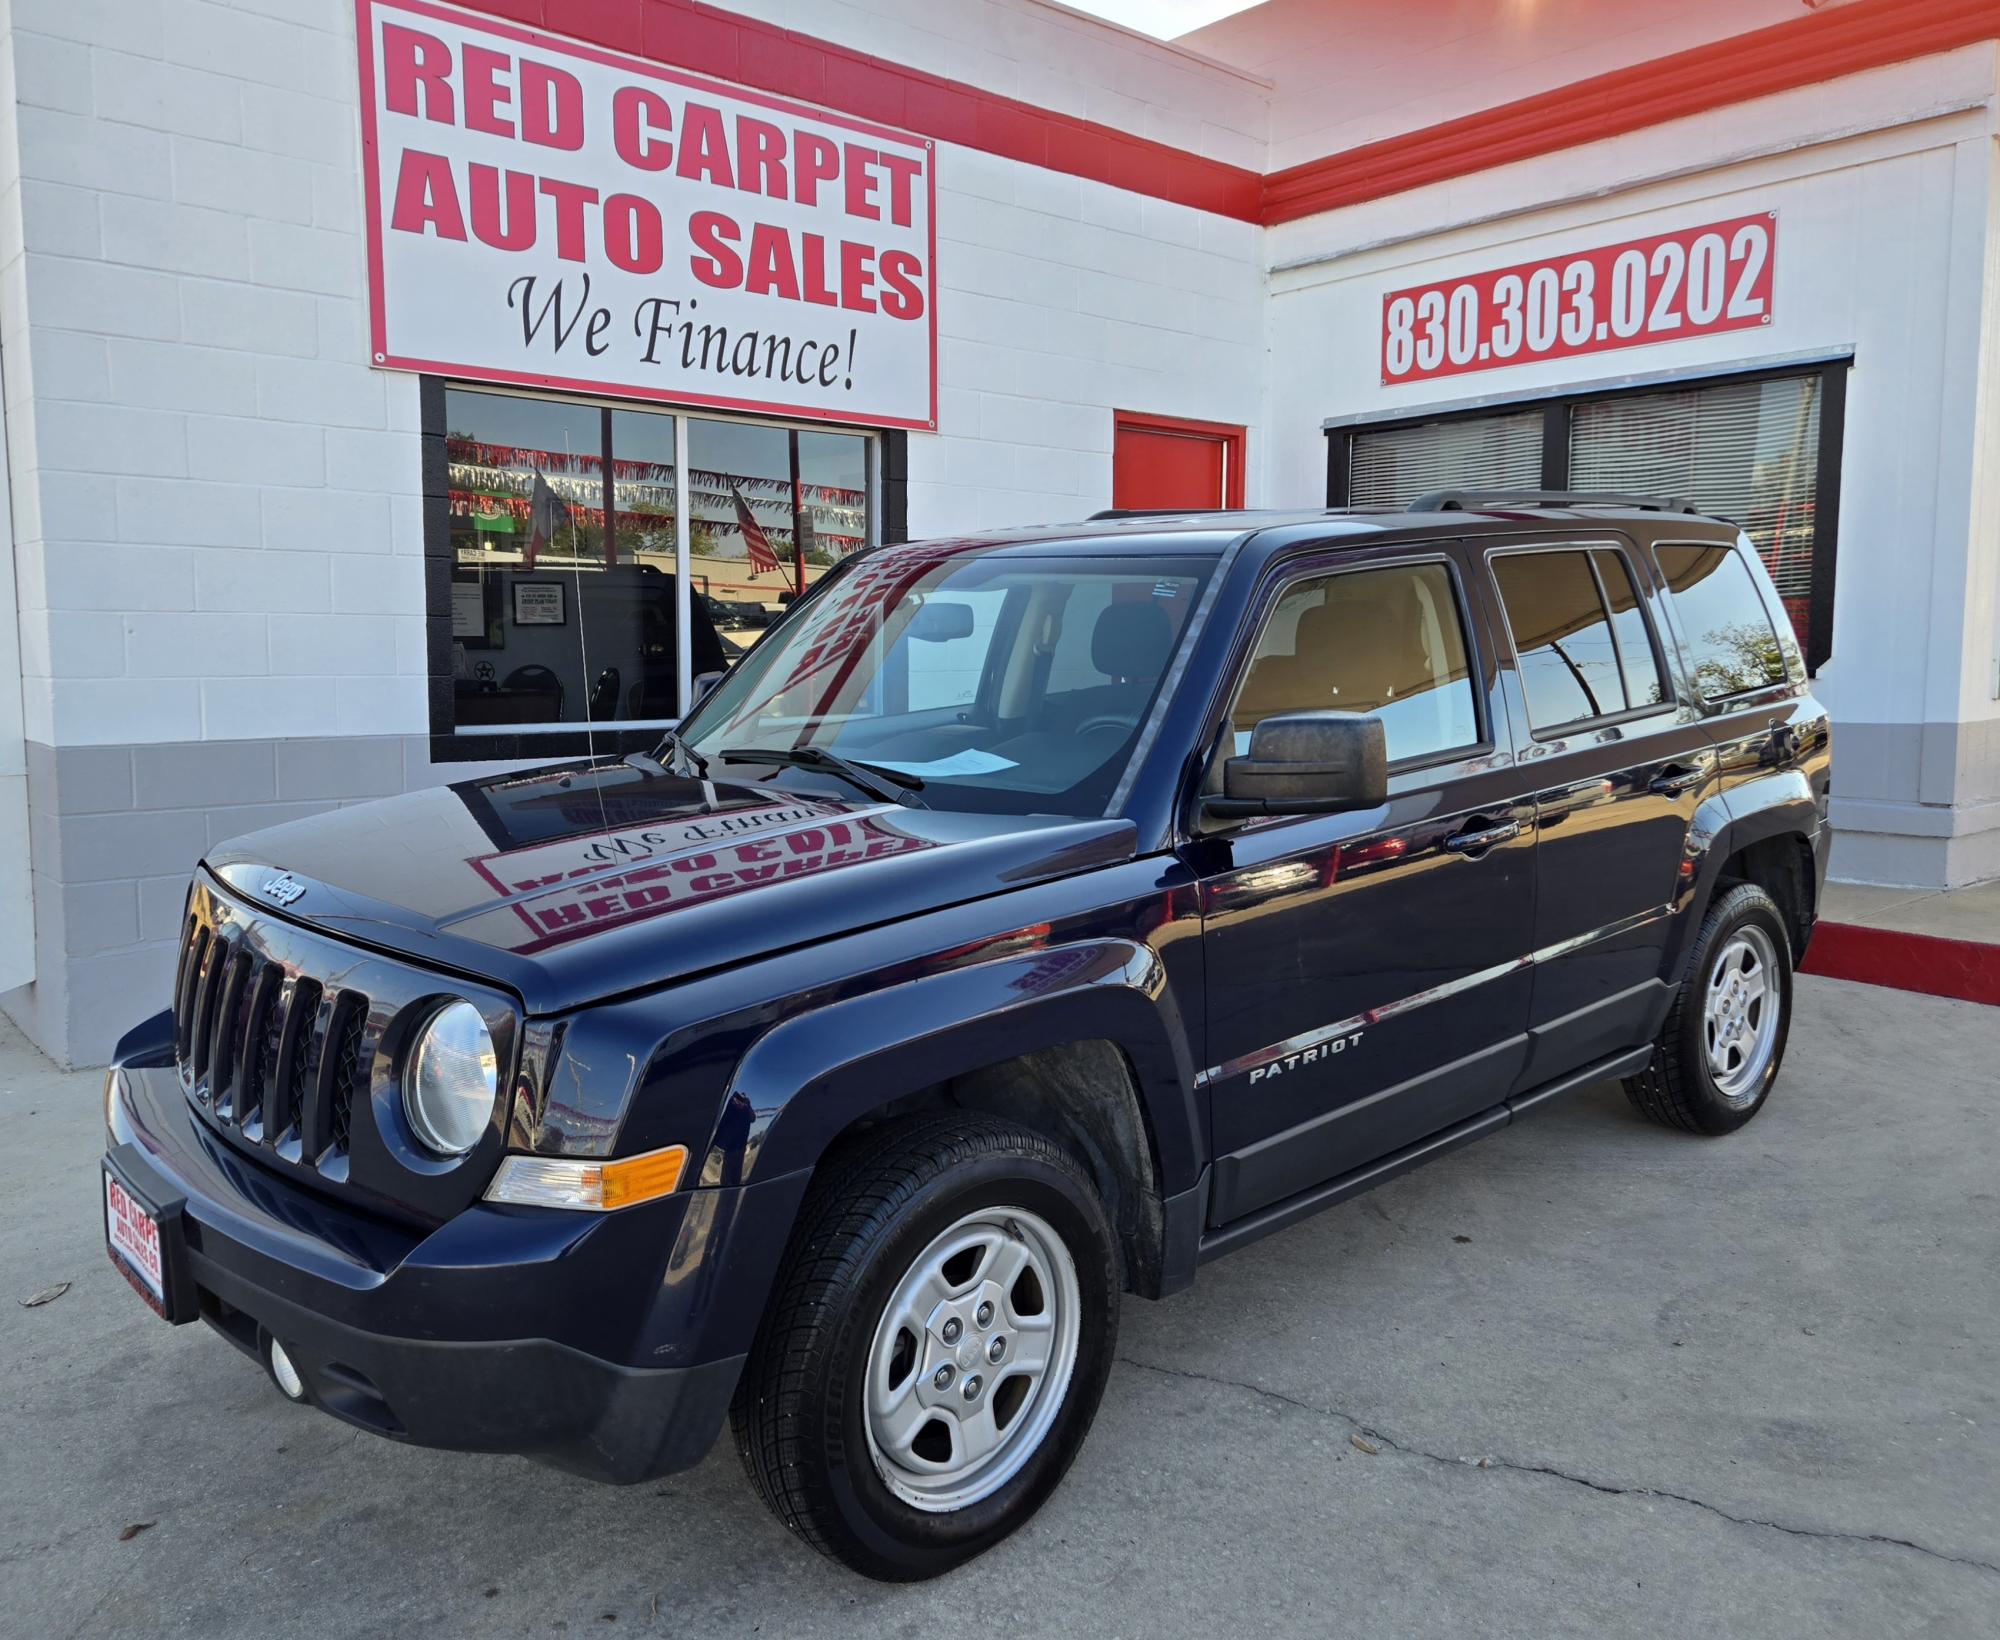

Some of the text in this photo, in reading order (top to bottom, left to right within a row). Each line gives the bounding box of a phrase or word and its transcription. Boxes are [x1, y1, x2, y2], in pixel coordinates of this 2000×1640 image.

[382, 21, 922, 228] RED CARPET
[391, 147, 925, 321] AUTO SALES
[506, 272, 858, 390] We Finance!
[1386, 224, 1769, 375] 830.303.0202
[263, 871, 307, 907] Jeep
[1249, 1031, 1364, 1086] PATRIOT
[110, 1182, 159, 1252] RED CARPE
